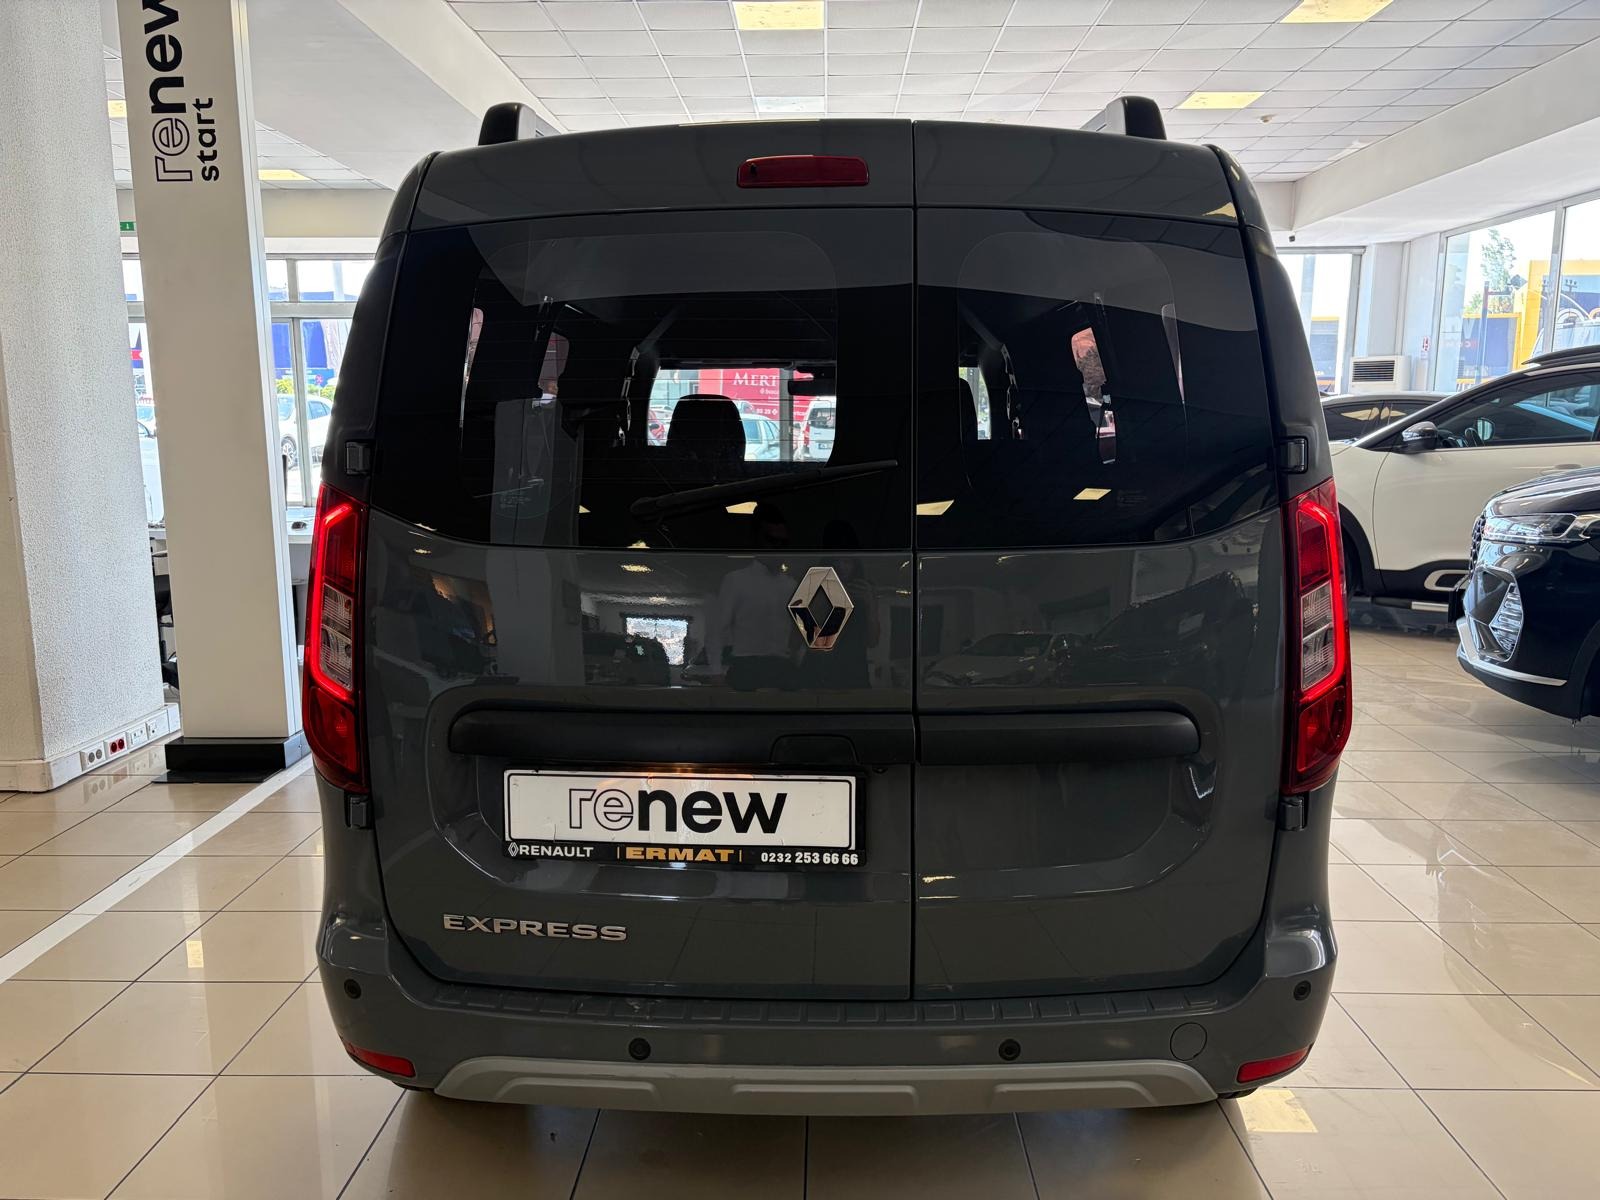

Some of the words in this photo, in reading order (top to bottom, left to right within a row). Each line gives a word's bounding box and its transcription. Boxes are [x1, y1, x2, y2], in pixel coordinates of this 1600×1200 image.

[192, 97, 220, 182] start
[568, 788, 788, 834] renew
[518, 845, 594, 858] RENAULT
[625, 846, 735, 863] ERMAT
[760, 852, 792, 863] 0232
[794, 851, 820, 864] 253
[822, 852, 840, 865] 66
[841, 853, 859, 866] 66
[443, 913, 627, 941] EXPRESS
